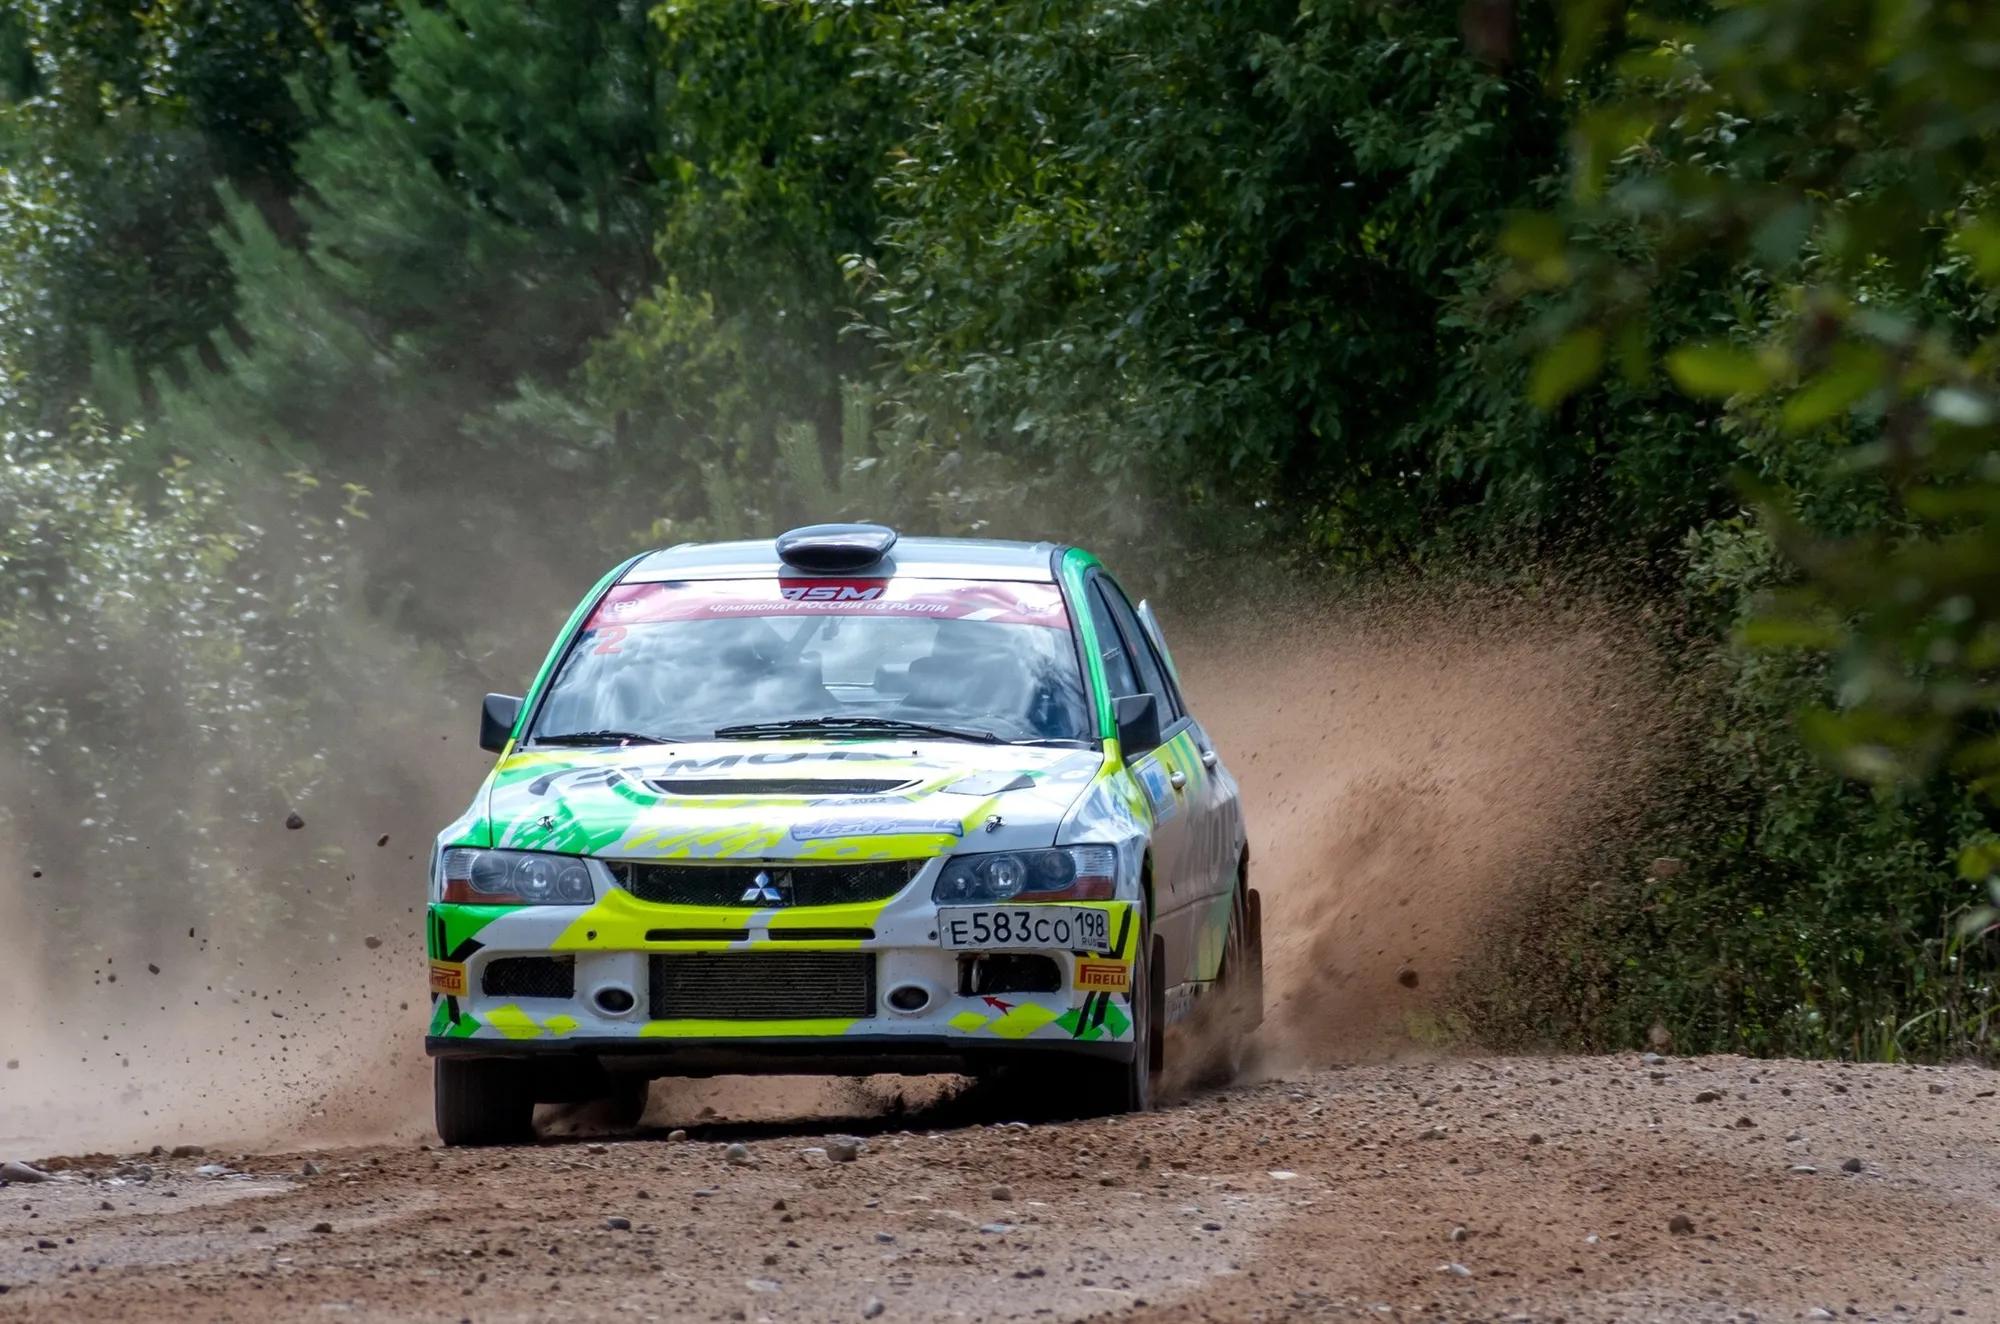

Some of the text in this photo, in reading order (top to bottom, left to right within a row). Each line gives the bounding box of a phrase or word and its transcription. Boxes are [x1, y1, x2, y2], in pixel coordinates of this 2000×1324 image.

[796, 601, 864, 611] РОССИИ
[888, 602, 949, 612] РАЛЛИ
[594, 626, 627, 655] 2
[951, 911, 1105, 945] E583CO 198
[1080, 964, 1126, 985] PIRELLI
